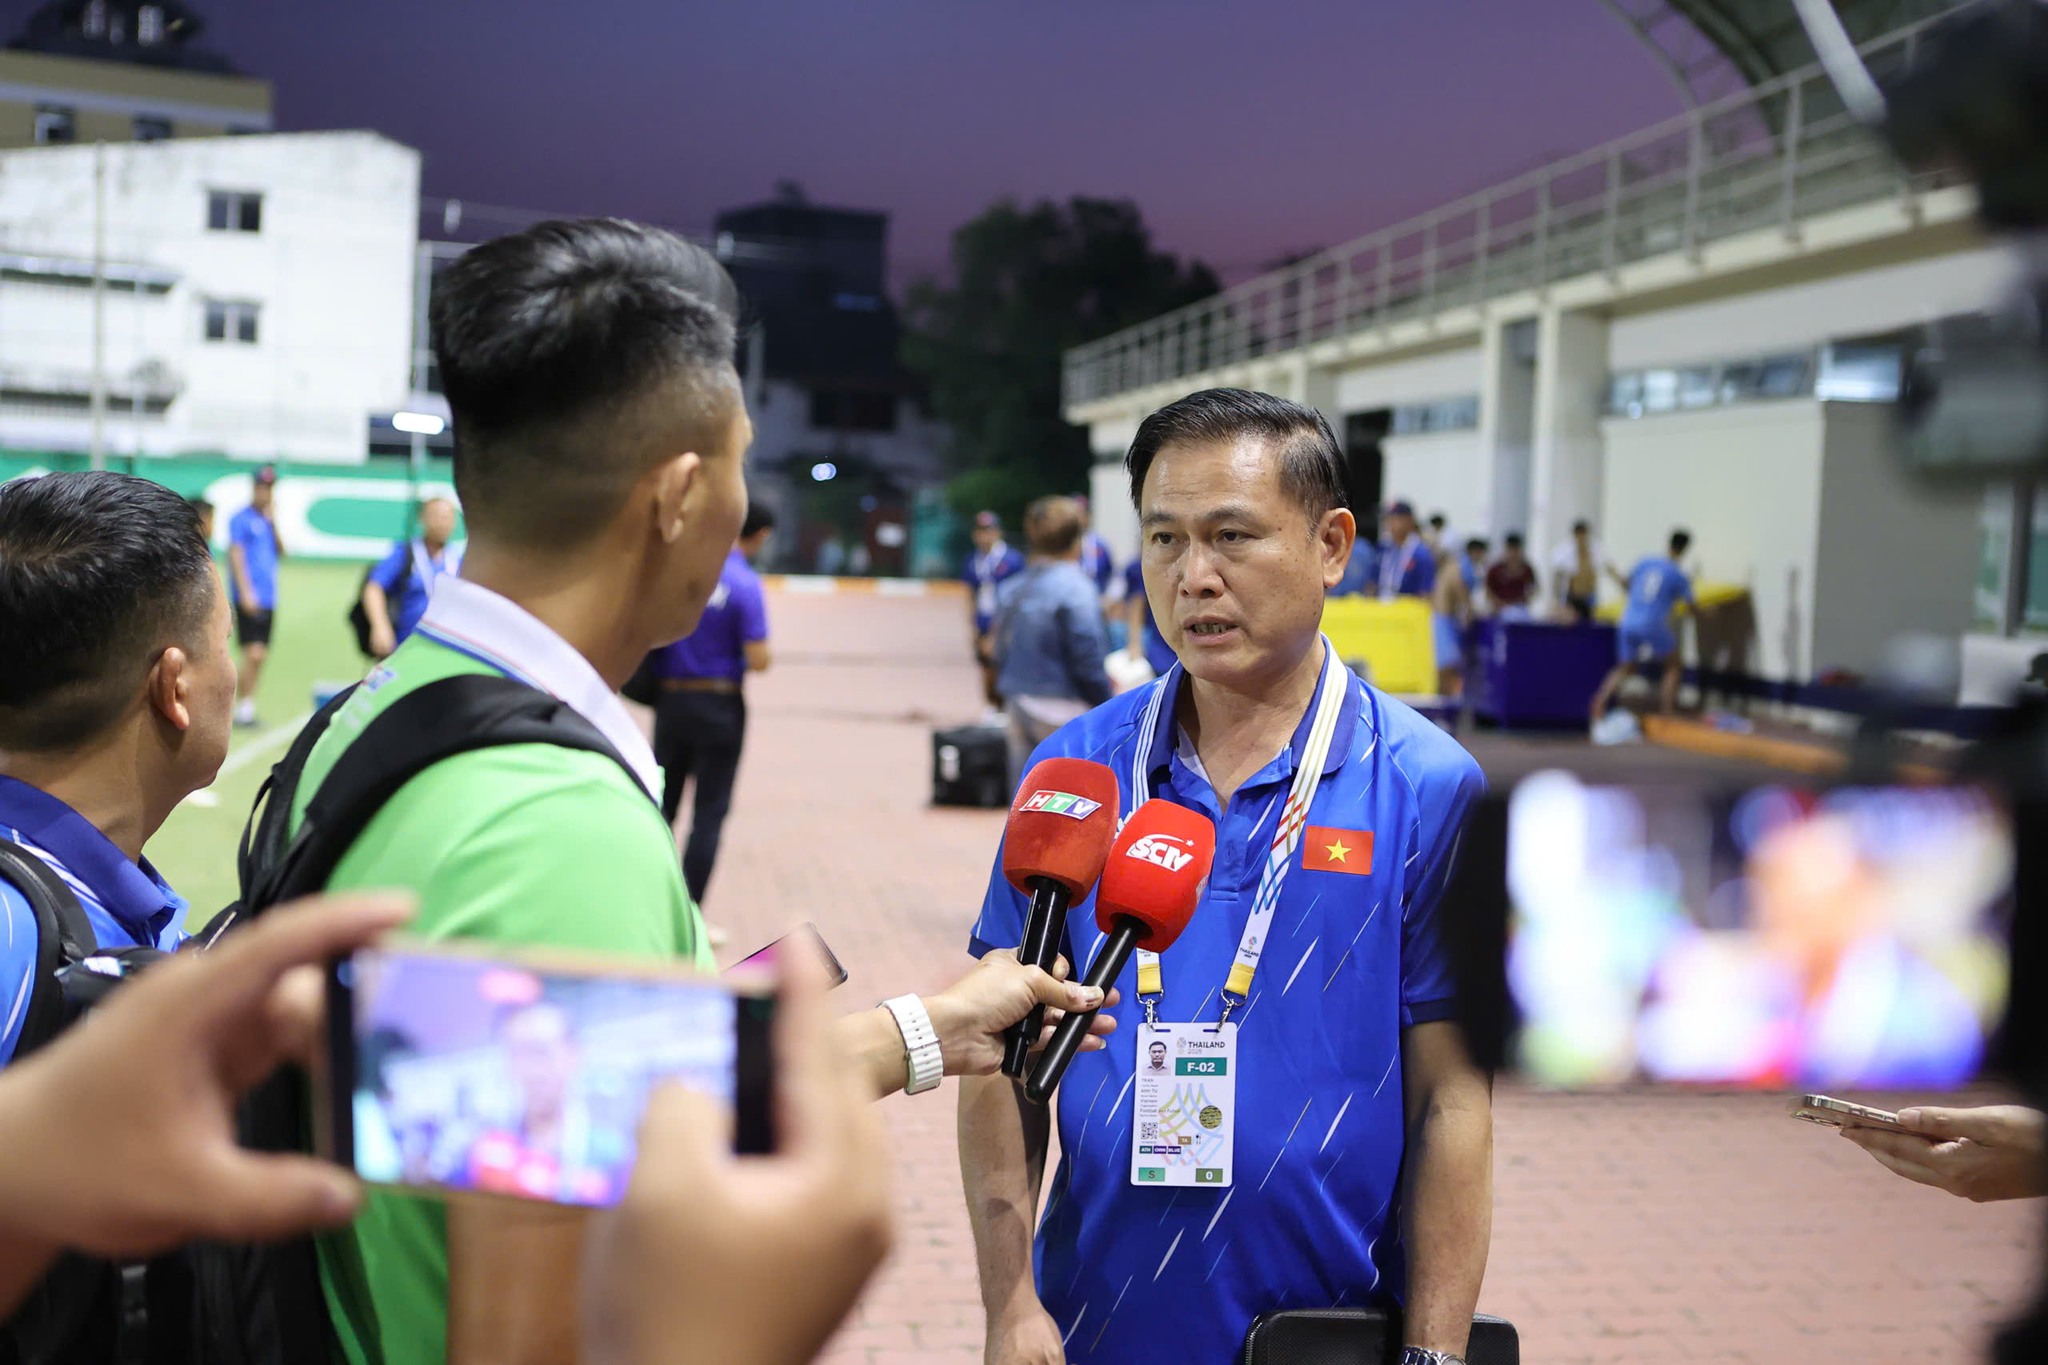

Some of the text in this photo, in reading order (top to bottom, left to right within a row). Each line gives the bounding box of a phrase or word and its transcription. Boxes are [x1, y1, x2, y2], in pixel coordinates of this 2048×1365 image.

[1025, 794, 1097, 815] HTV
[1126, 838, 1194, 872] SCTV
[1187, 1041, 1226, 1049] THAILAND
[1187, 1062, 1216, 1073] F-02
[1148, 1170, 1156, 1179] S
